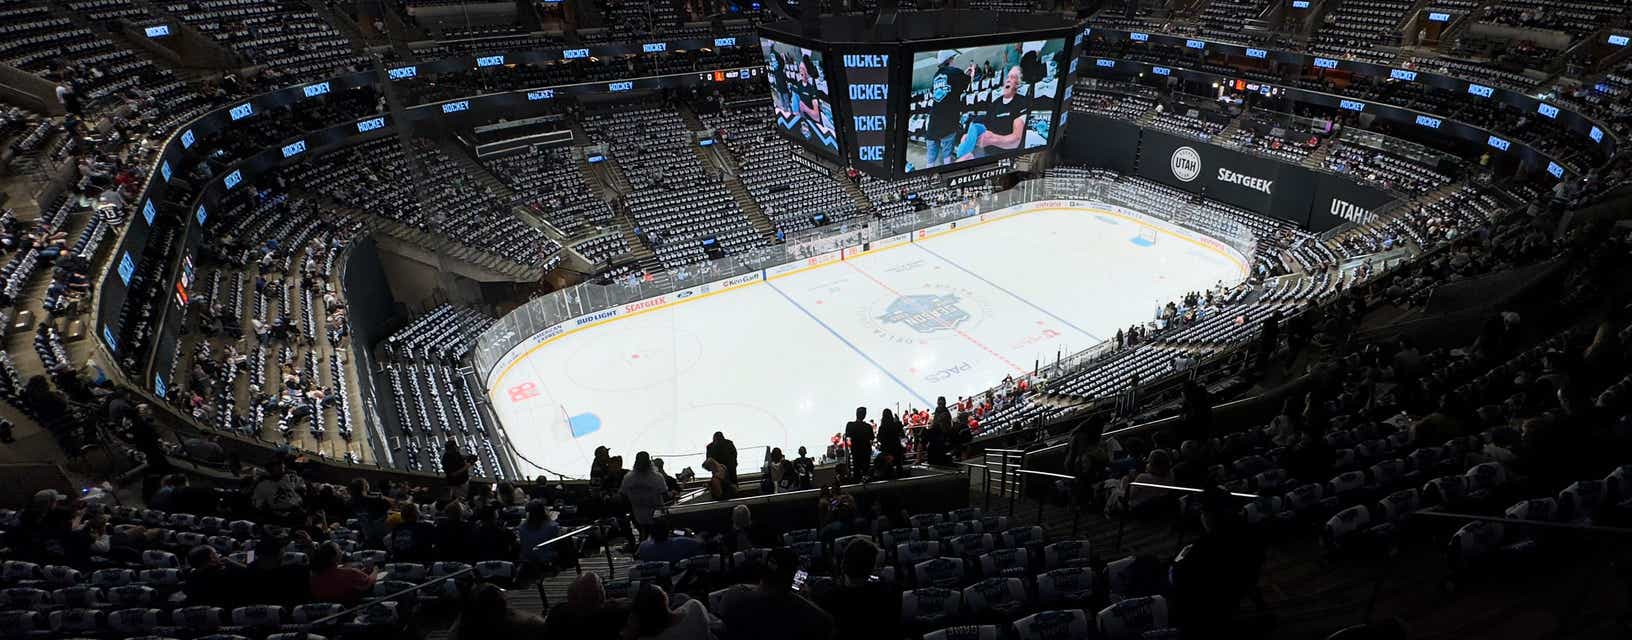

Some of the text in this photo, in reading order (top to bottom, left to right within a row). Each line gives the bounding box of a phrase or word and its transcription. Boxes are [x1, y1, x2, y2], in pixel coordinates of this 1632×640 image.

[643, 42, 667, 53] HOCKEY
[715, 38, 736, 47] HOCKEY
[563, 49, 590, 59] HOCKEY
[477, 56, 504, 67] HOCKEY
[1314, 57, 1339, 69] HOCKEY
[388, 65, 417, 80] HOCKEY
[1391, 69, 1418, 80] HOCKEY
[304, 82, 330, 97] HOCKEY
[609, 82, 633, 92] HOCKEY
[1468, 84, 1495, 97] HOCKEY
[528, 89, 555, 101] HOCKEY
[230, 103, 253, 121] HOCKEY
[442, 101, 469, 113] HOCKEY
[1340, 100, 1366, 111] HOCKEY
[357, 117, 385, 132] HOCKEY
[1416, 115, 1442, 128] HOCKEY
[282, 140, 306, 157] HOCKEY
[1175, 157, 1197, 173] UTAH
[957, 167, 1007, 185] DELTA CENTER
[1217, 167, 1273, 194] SEATGEEK
[104, 208, 116, 219] 13
[1330, 198, 1364, 224] UTAH
[625, 296, 666, 313] SEATGEEK
[576, 310, 618, 325] BUD LIGHT
[533, 325, 562, 340] AMERICAN
